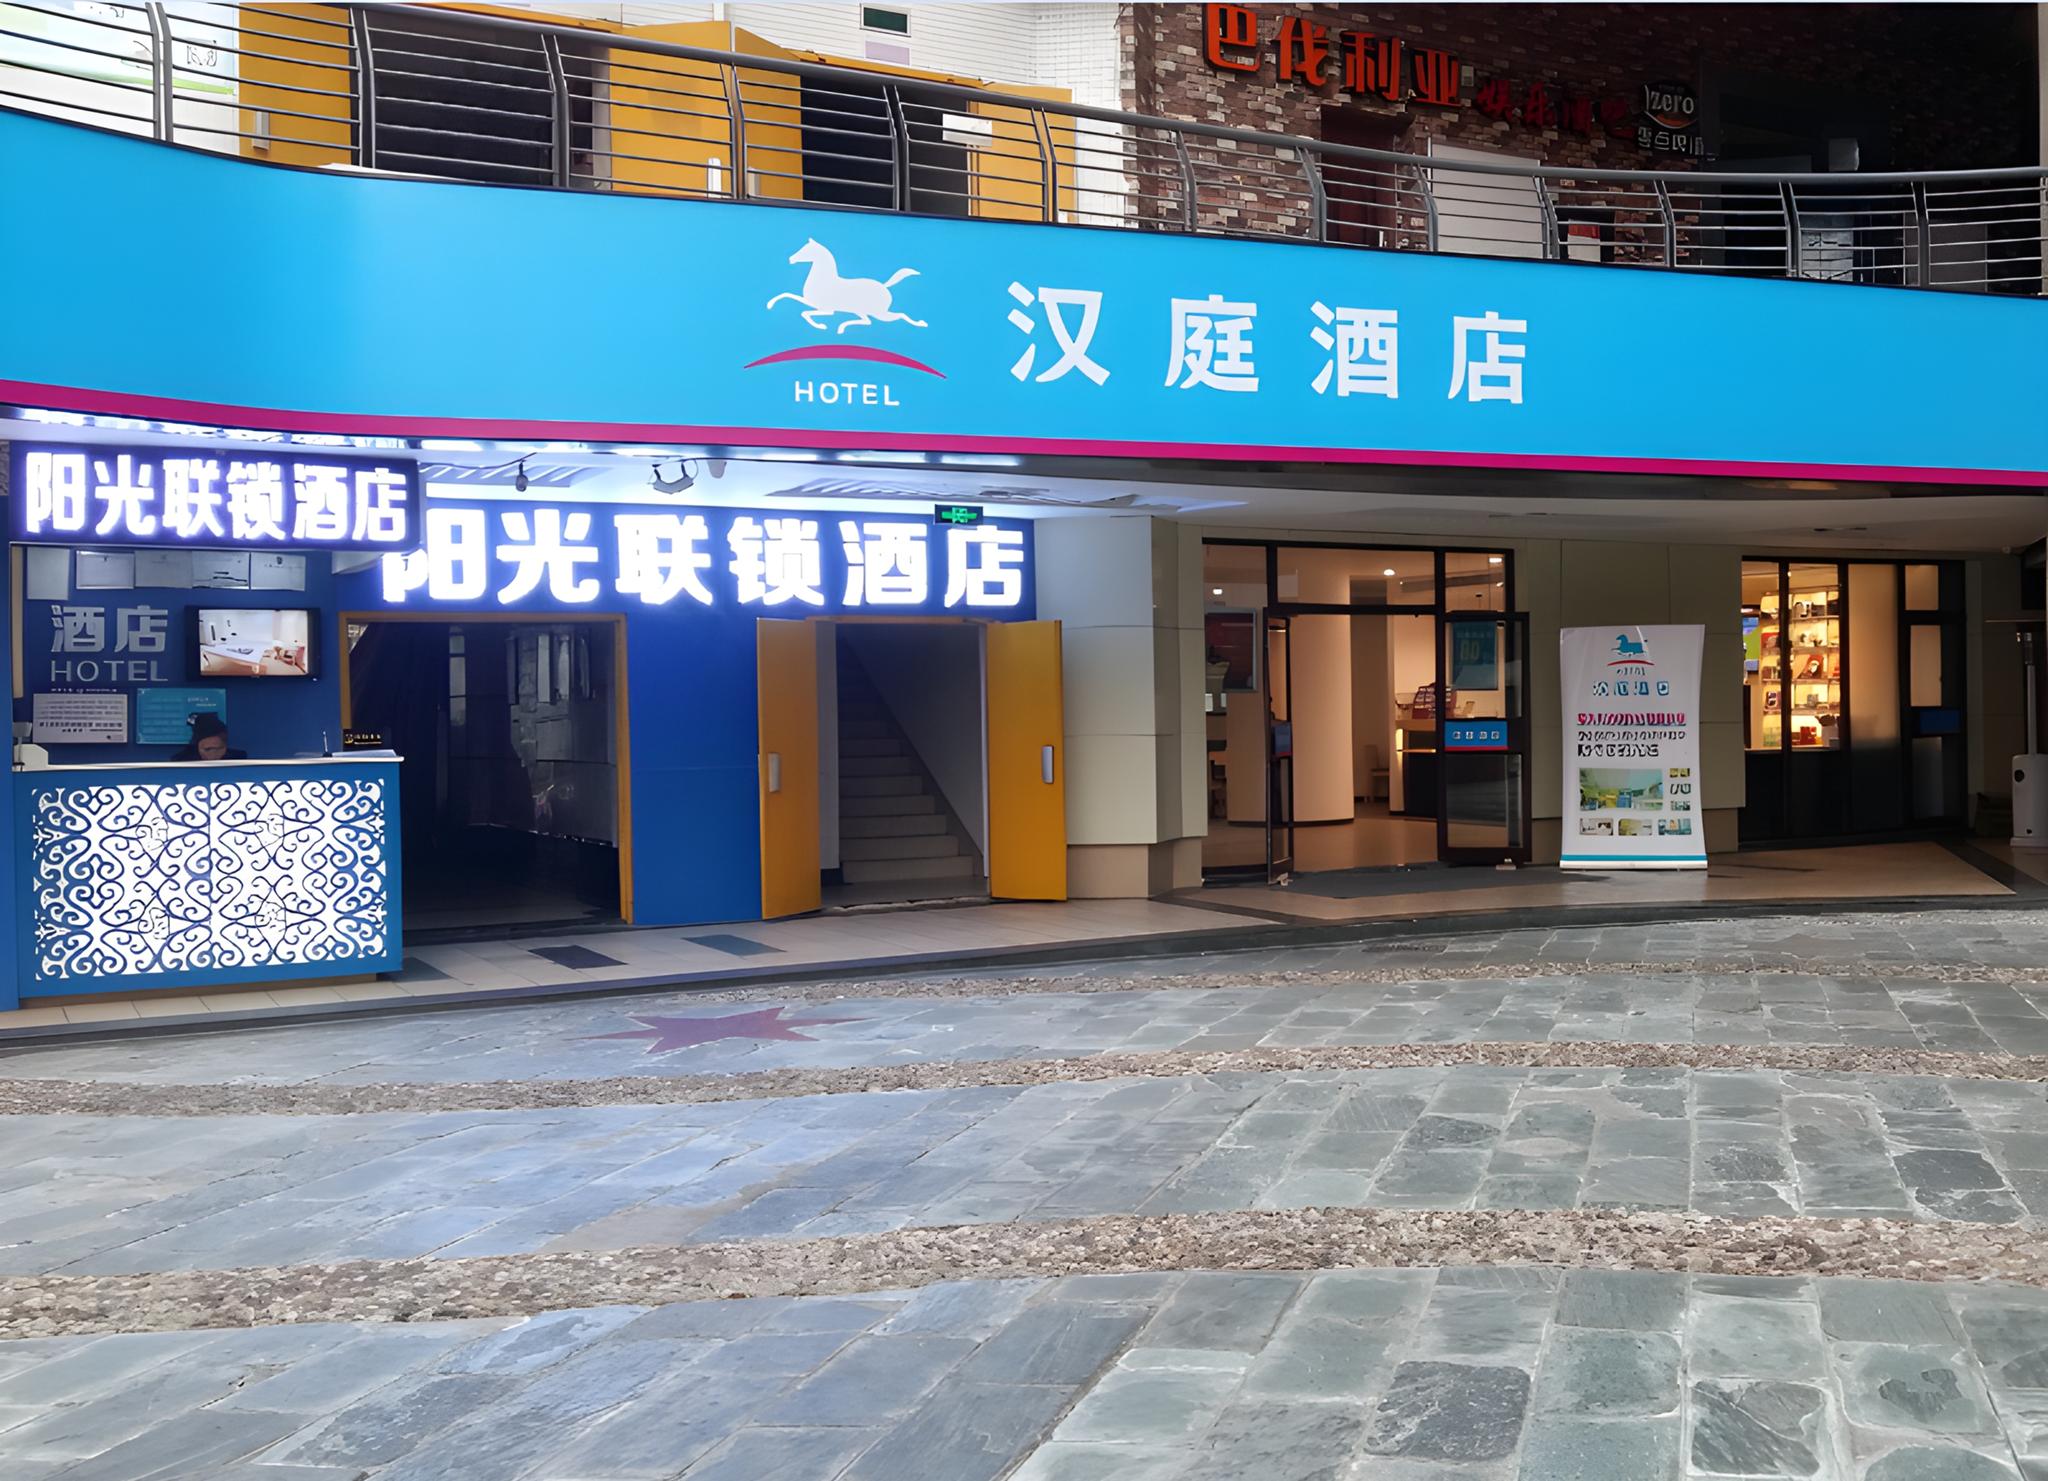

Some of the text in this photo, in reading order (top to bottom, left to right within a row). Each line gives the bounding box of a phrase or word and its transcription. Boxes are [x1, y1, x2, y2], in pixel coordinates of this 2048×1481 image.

[1204, 3, 1463, 108] 巴伐利亚
[1649, 90, 1696, 115] zero
[1007, 280, 1528, 404] 汉庭酒店
[794, 379, 900, 406] HOTEL
[25, 451, 408, 541] 阳光联锁酒店
[381, 504, 1026, 607] 阳光联锁酒店
[50, 604, 169, 653] 酒店
[50, 659, 169, 683] HOTEL
